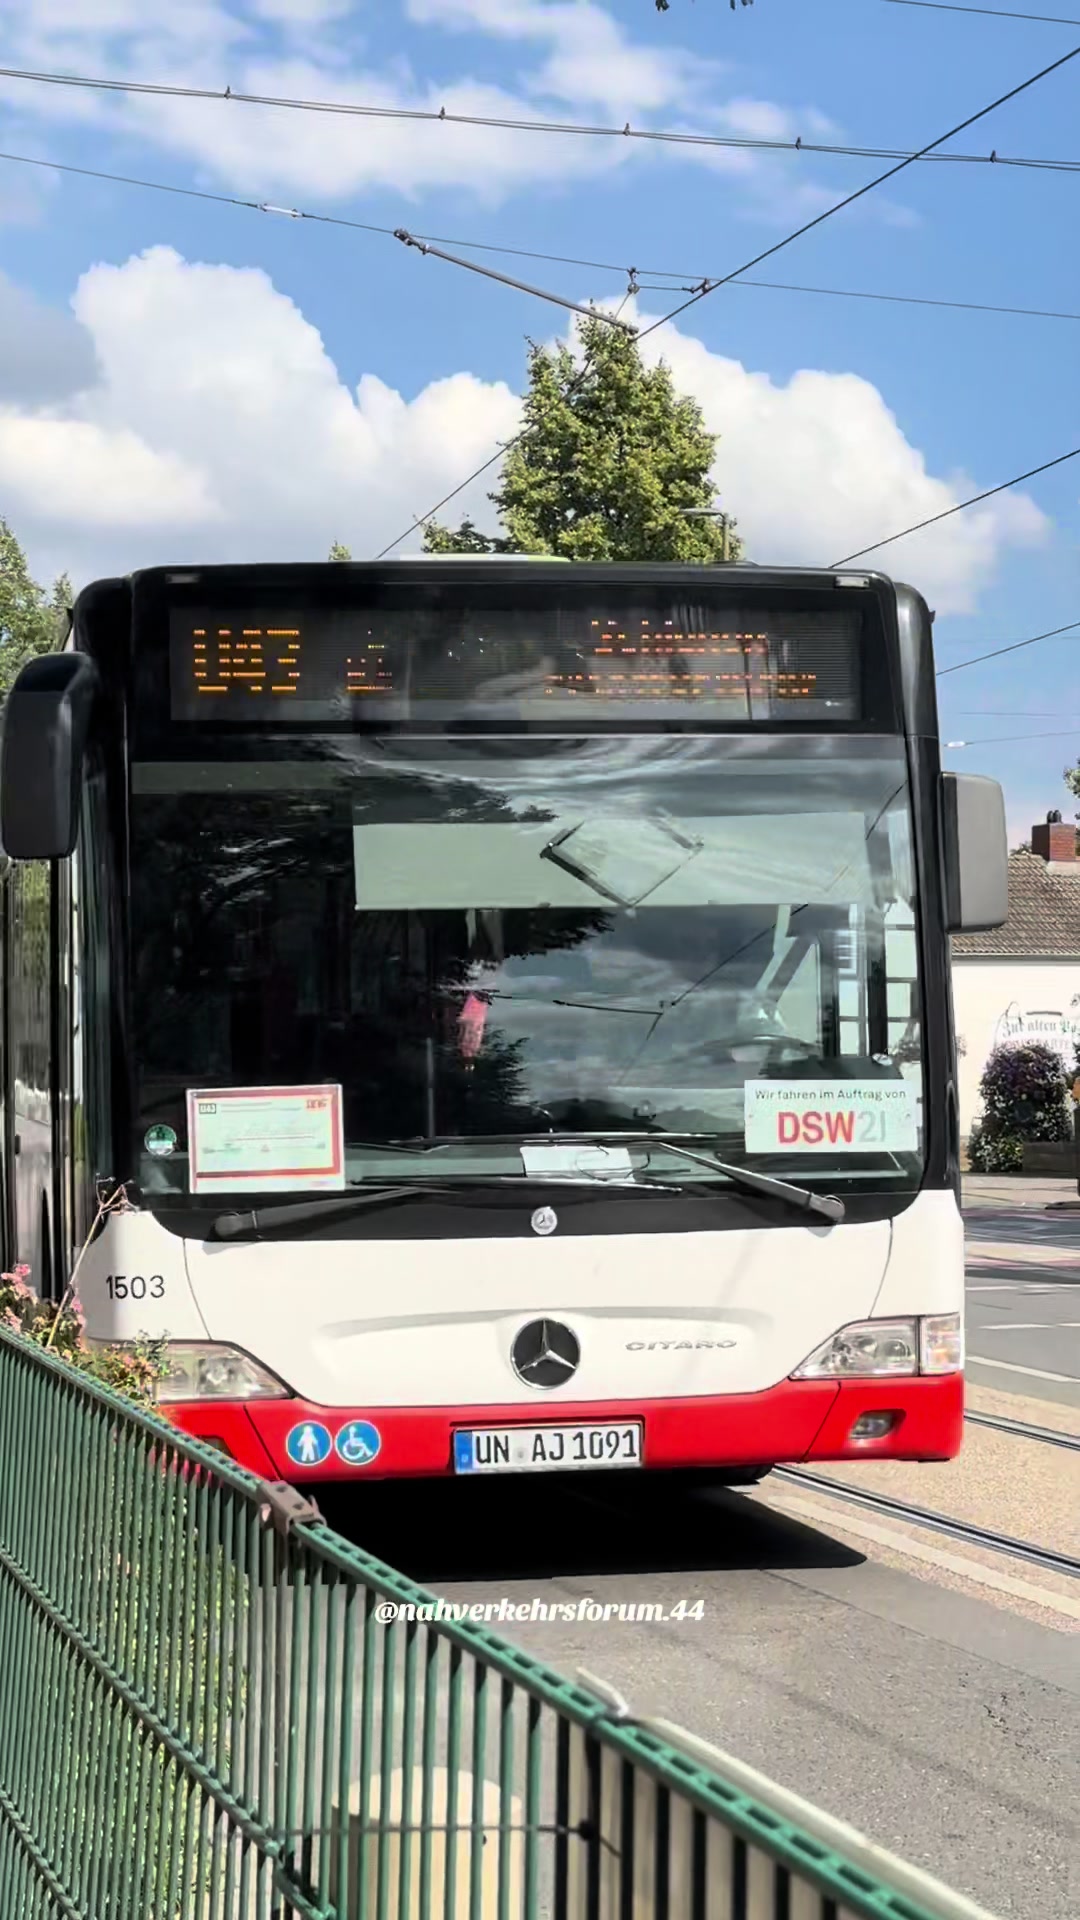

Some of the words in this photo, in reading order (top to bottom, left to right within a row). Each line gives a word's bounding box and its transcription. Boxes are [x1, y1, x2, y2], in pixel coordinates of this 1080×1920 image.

[755, 1089, 774, 1100] Wir
[778, 1089, 816, 1100] fahren
[820, 1089, 834, 1100] im
[837, 1089, 883, 1102] Auftrag
[885, 1090, 906, 1100] von
[106, 1274, 165, 1300] 1503
[625, 1339, 738, 1351] CITARO
[475, 1435, 510, 1464] UN
[532, 1432, 565, 1462] AJ
[572, 1429, 637, 1460] 1091
